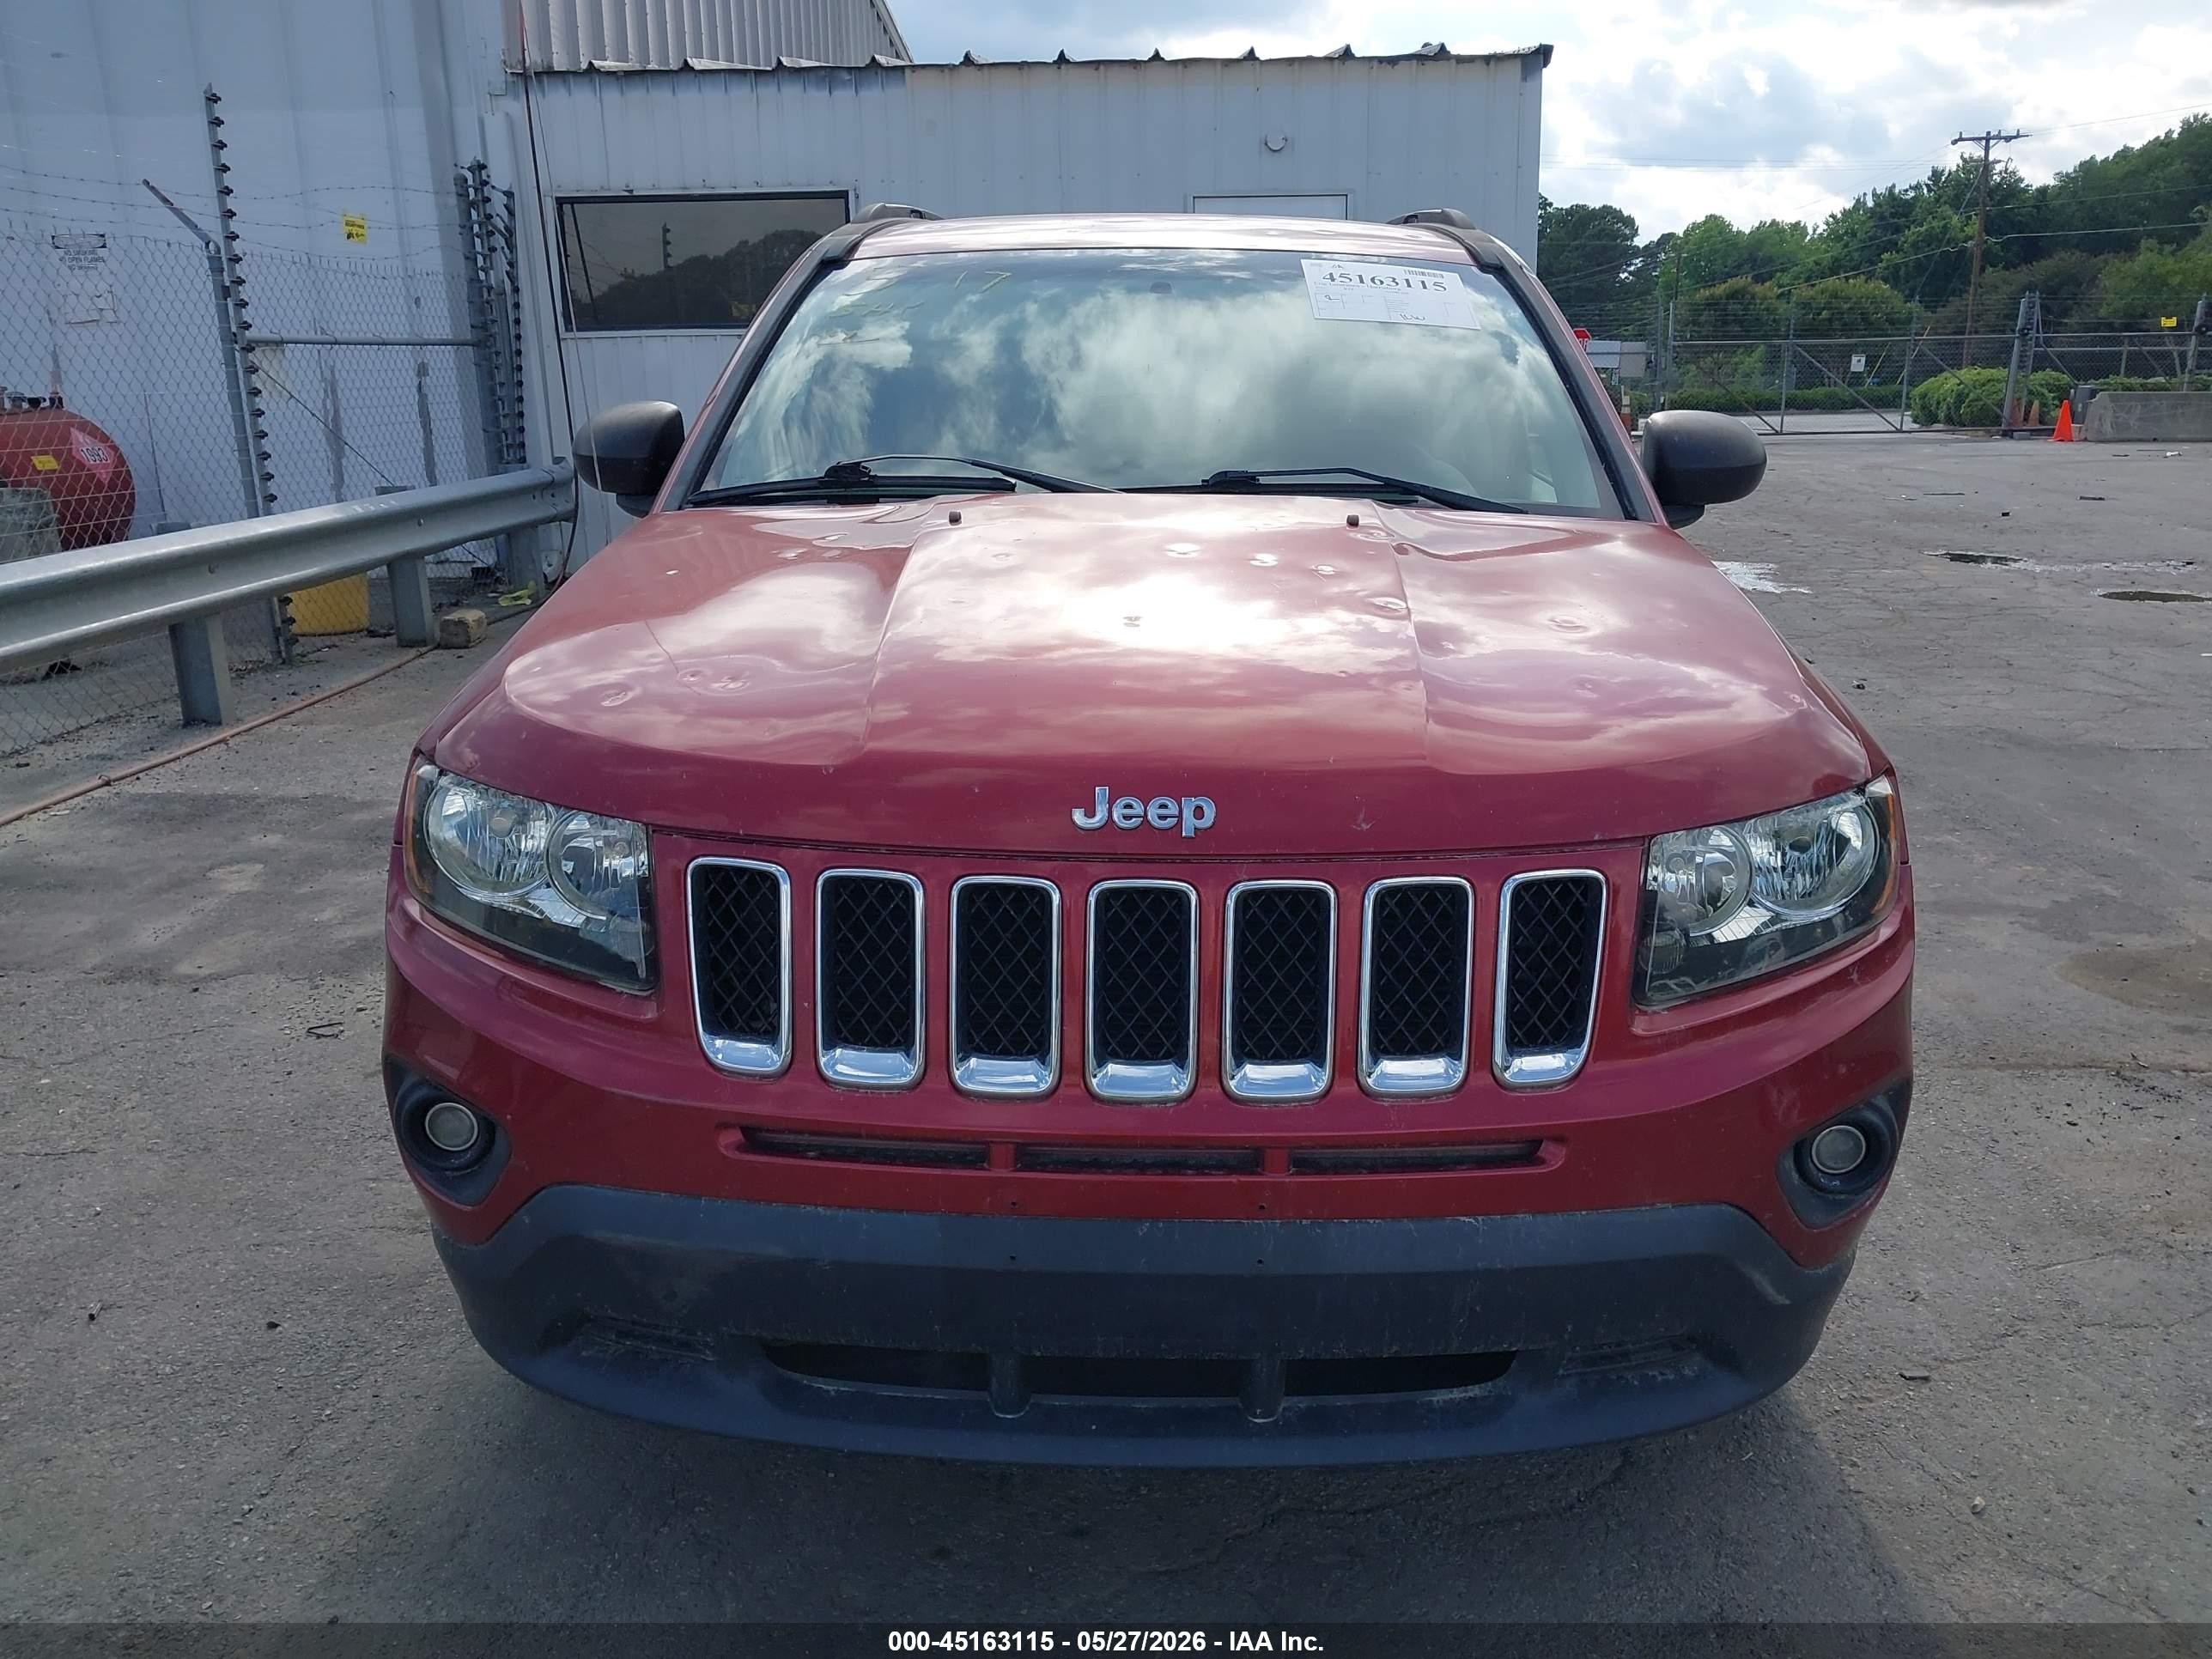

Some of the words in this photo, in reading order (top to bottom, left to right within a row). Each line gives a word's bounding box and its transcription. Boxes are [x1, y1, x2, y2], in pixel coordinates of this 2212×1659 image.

[1322, 271, 1448, 292] 45163115
[81, 447, 108, 462] 1993
[1072, 787, 1217, 838] Jeep
